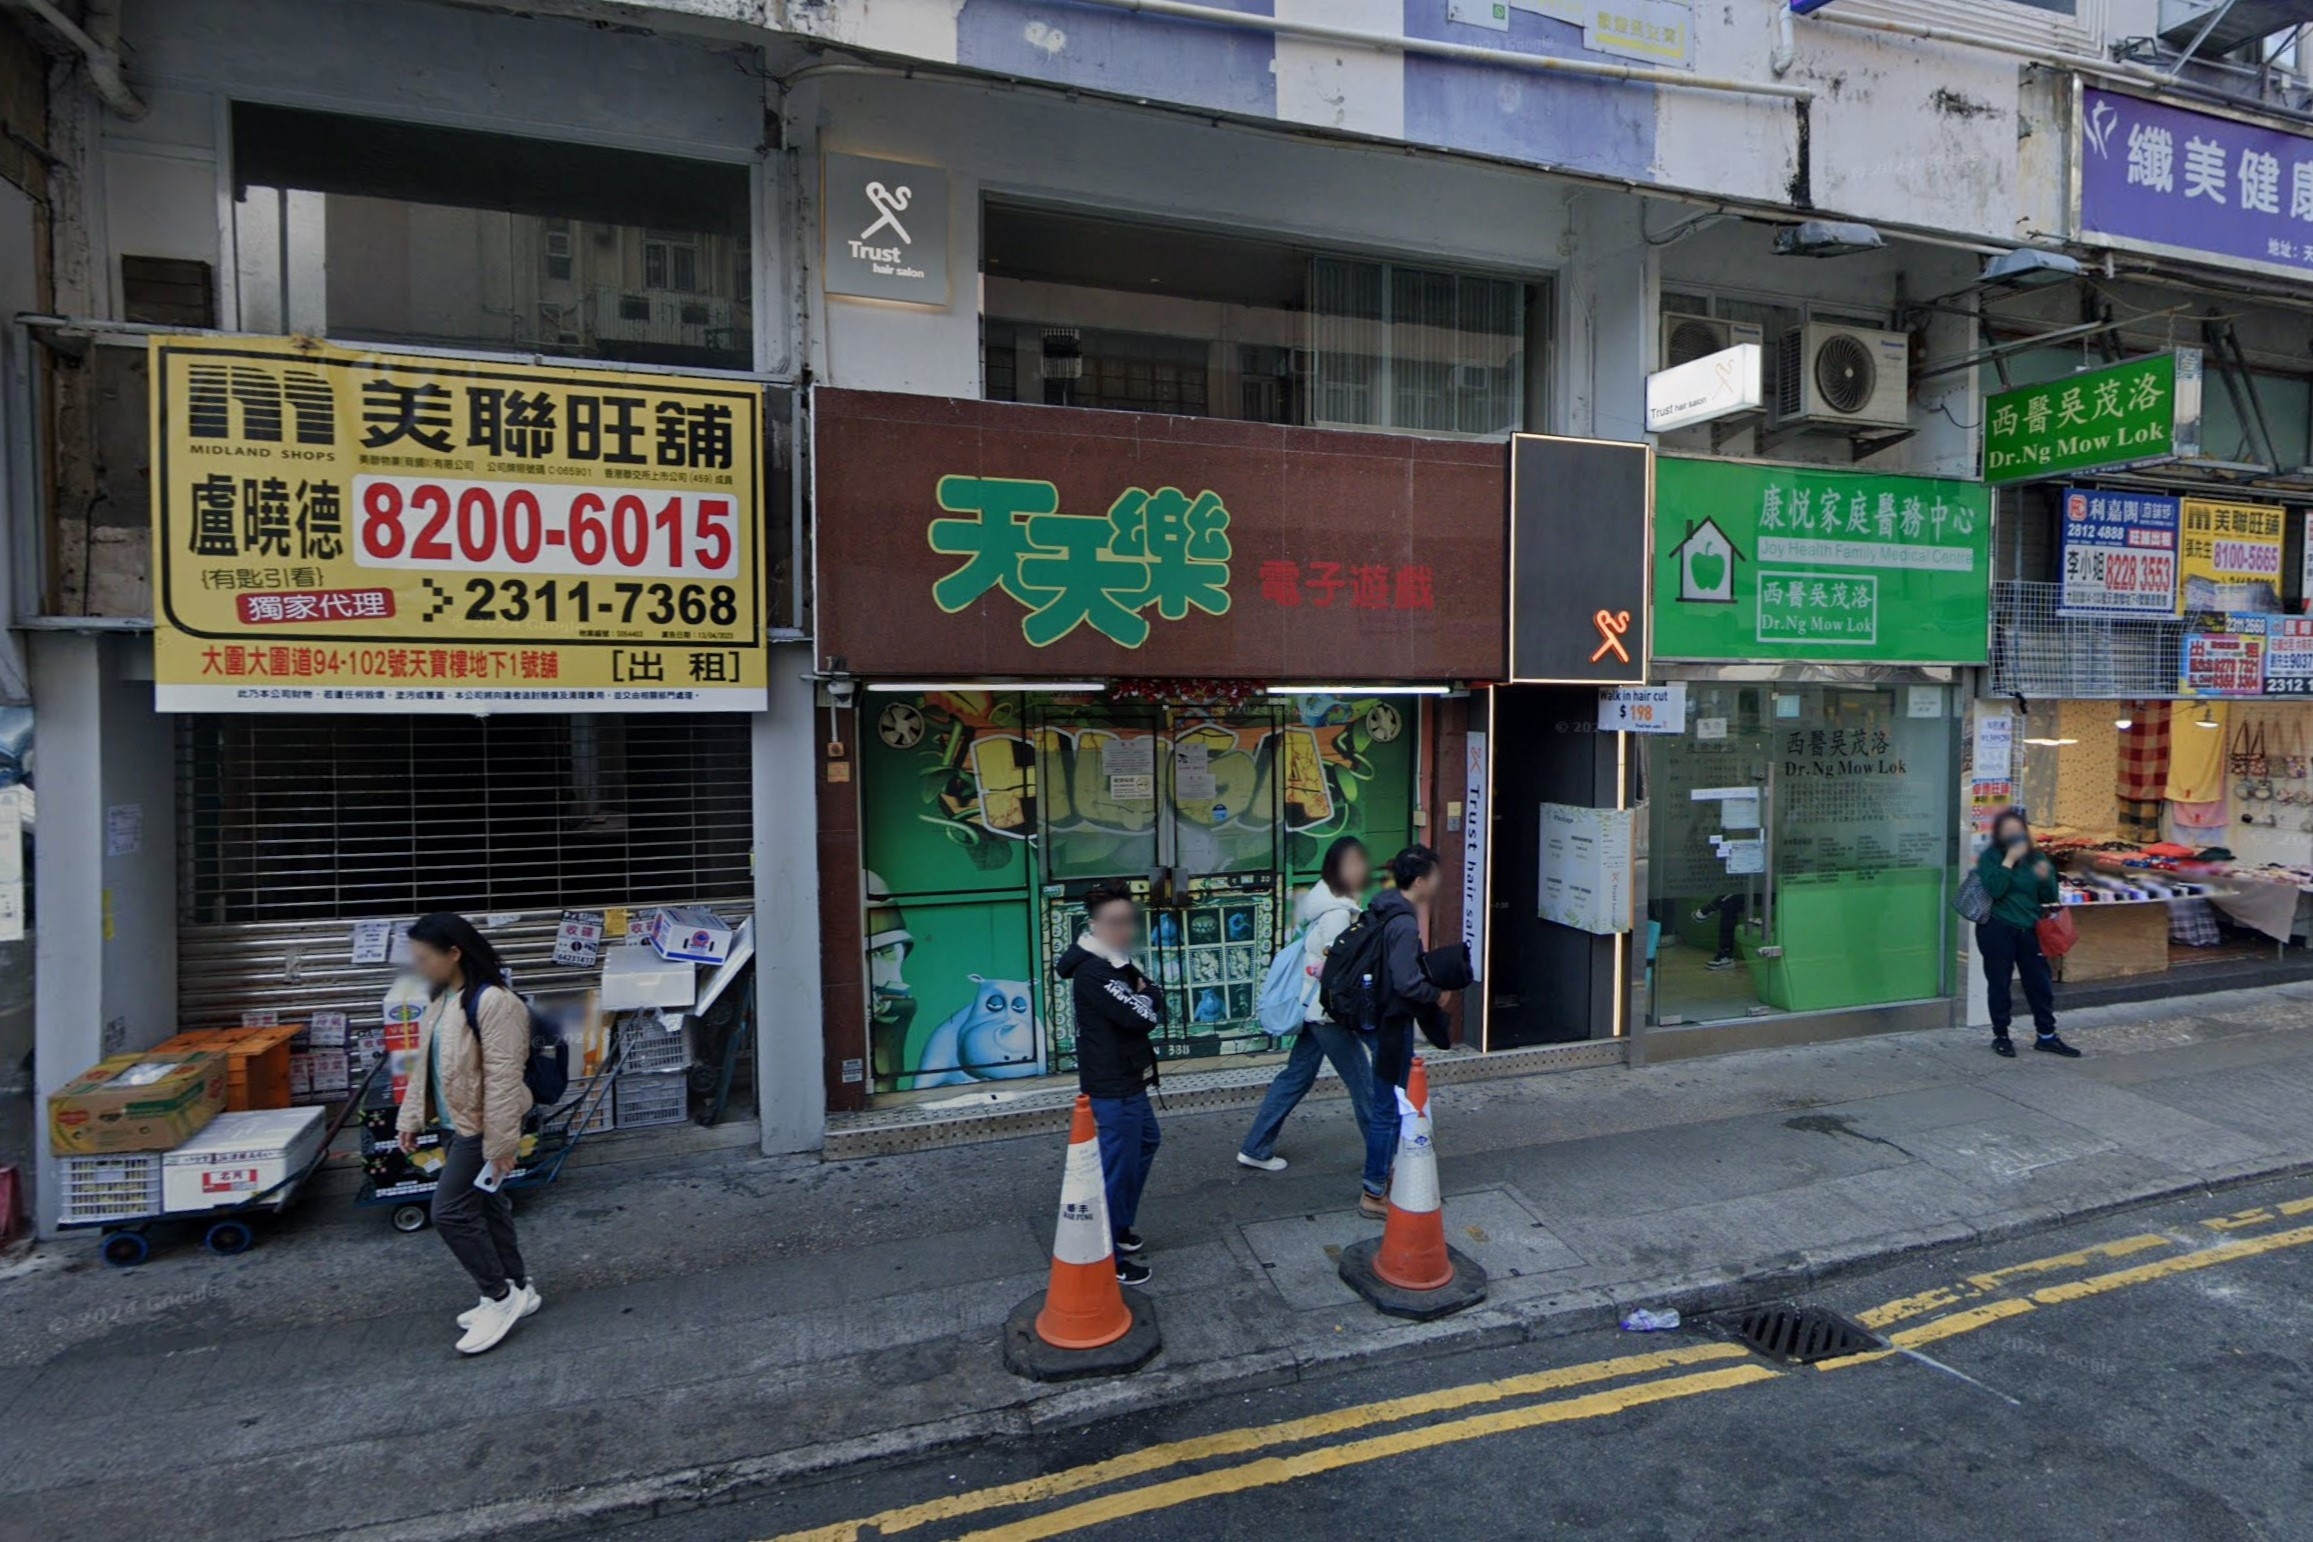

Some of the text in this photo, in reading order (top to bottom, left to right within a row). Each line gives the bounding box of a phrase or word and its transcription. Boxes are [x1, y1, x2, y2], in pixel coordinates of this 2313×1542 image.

[848, 240, 901, 263] Trust
[873, 263, 925, 279] hair salon
[1650, 403, 1674, 420] Trust
[1992, 372, 2166, 437] 西醫吳茂洛
[359, 379, 733, 470] 美聯旺舖
[190, 444, 336, 462] MIDLAND SHOPS
[1989, 443, 2051, 469] Dr.Ng
[2056, 433, 2112, 458] Mow
[2117, 421, 2164, 448] Lok
[188, 473, 344, 560] 盧曉德
[2089, 498, 2139, 523] 利嘉閣
[2214, 509, 2280, 536] 美聯旺舖
[362, 481, 733, 571] 8200-6015
[927, 474, 1233, 649] 天天樂
[1761, 542, 1974, 566] Joy Health Family Medical Centre
[1259, 560, 1435, 611] 電子遊戲
[2105, 553, 2171, 592] 8228 3553
[248, 592, 388, 622] 獨家代理
[465, 578, 738, 626] 2311-7368
[1763, 580, 1874, 611] 西醫吳茂洛
[1762, 614, 1873, 635] Dr.Ng Mow Lok
[1600, 689, 1668, 702] Walk in hair cut
[2266, 678, 2304, 692] 2312
[1630, 704, 1653, 721] 198
[1785, 759, 1907, 780] Dr.Ng Mow Lok
[1467, 785, 1480, 851] Trust
[1466, 861, 1477, 902] hair
